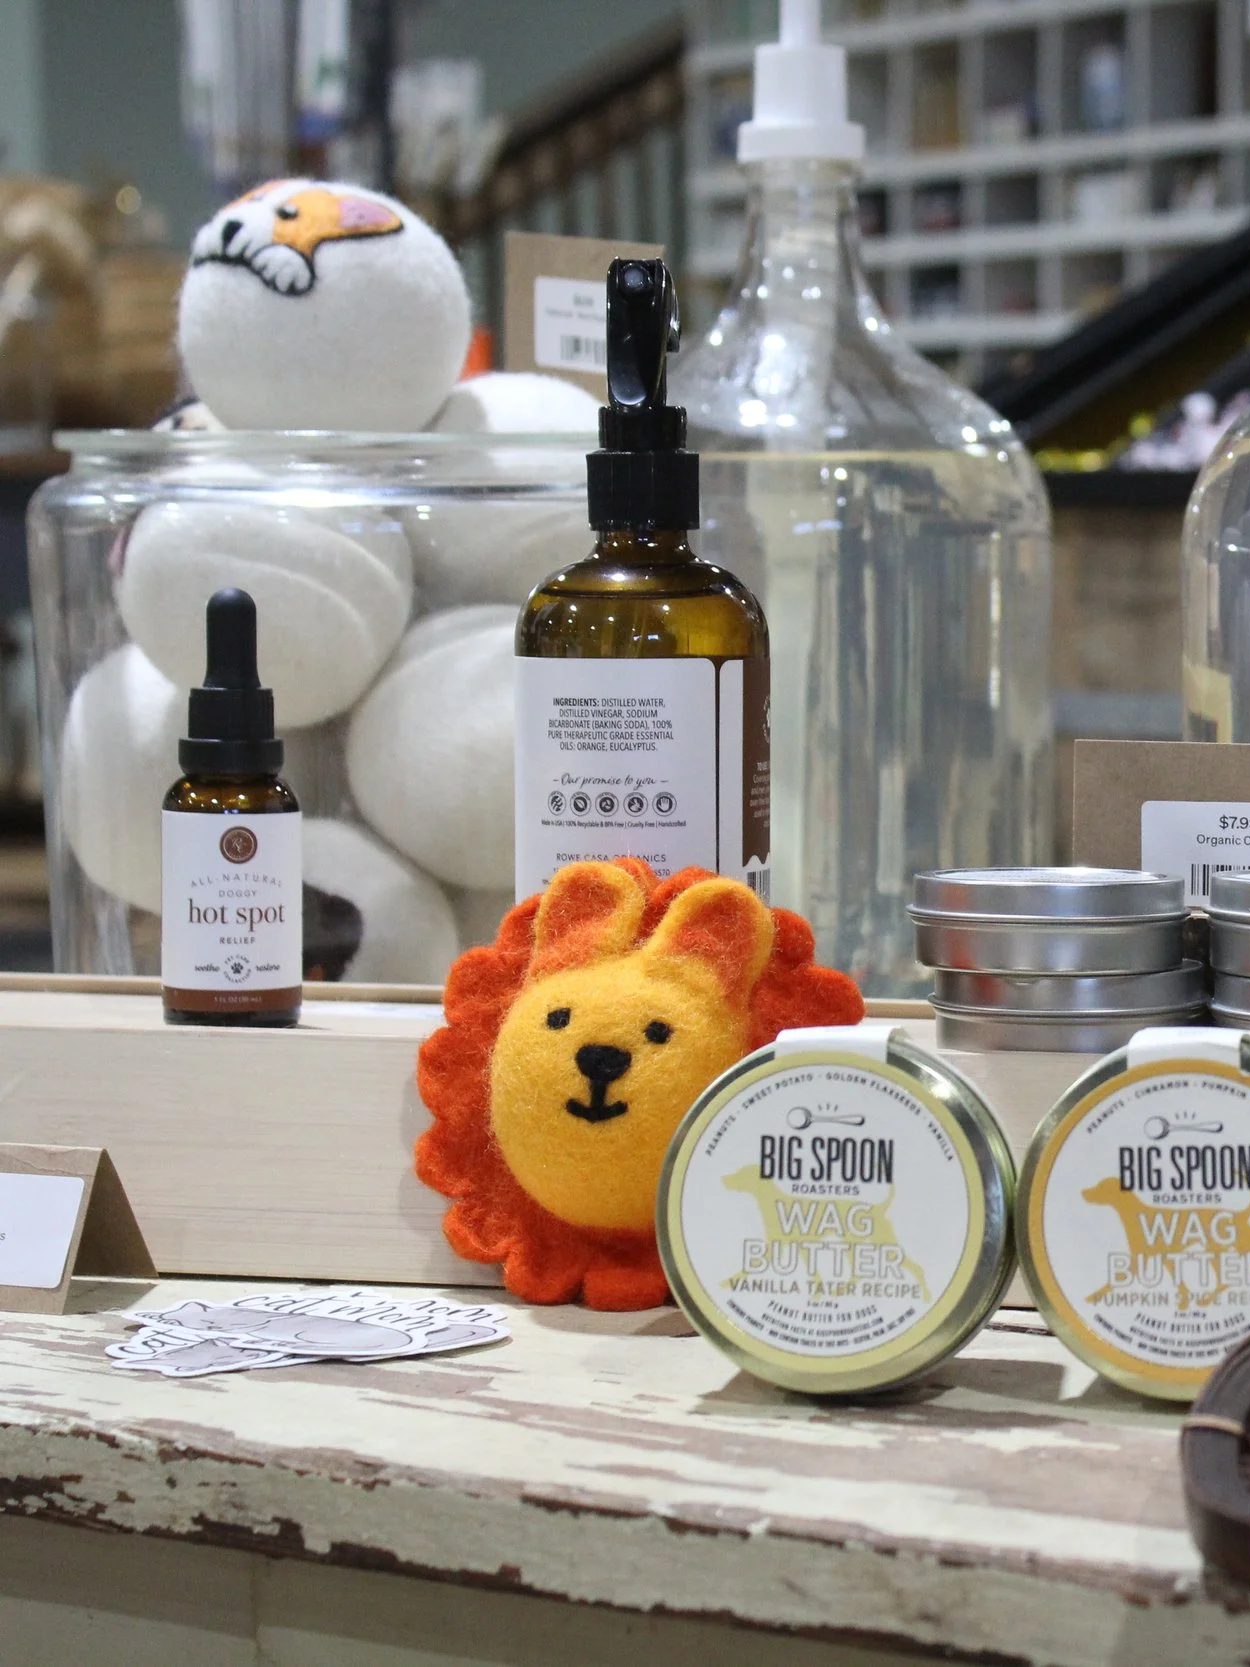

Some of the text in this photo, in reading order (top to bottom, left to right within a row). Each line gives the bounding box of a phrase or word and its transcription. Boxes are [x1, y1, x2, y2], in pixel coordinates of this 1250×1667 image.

[553, 697, 666, 708] INGREDIENTS: DISTILLED WATER,
[559, 708, 658, 719] DISTILLED VINEGAR, SODIUM
[548, 719, 673, 730] BICARBONATE (BAKING SODA), 100%
[548, 730, 674, 740] PURE THERAPEUTIC GRADE ESSENTIAL
[560, 741, 658, 752] OILS: ORANGE, EUCALYPTUS.
[561, 772, 657, 791] Our promise to you
[1196, 834, 1241, 847] Organic
[556, 853, 580, 861] ROWE
[218, 889, 258, 898] DOGGY
[188, 898, 285, 932] hot spot
[219, 936, 256, 945] RELIEF
[1086, 1099, 1125, 1134] PEANUTS
[1134, 1080, 1189, 1099] CINNAMON
[1202, 1080, 1247, 1098] PUMPKIN
[705, 1115, 736, 1157] PEANUTS
[742, 1085, 773, 1110] SWEET
[774, 1072, 813, 1090] POTATO
[826, 1071, 867, 1085] GOLDEN
[928, 1121, 953, 1162] VANILLA
[760, 1135, 894, 1184] BIG SPOON
[1119, 1146, 1162, 1191] BIG
[791, 1183, 861, 1196] ROASTERS
[1152, 1193, 1222, 1204] ROASTERS
[775, 1199, 875, 1238] WAG
[1138, 1211, 1238, 1248] WAG
[742, 1237, 906, 1280] BUTTER
[730, 1277, 921, 1299] VANILLA TATER RECIPE
[1092, 1291, 1169, 1307] PUMPKIN
[233, 1295, 435, 1332] cat mom
[118, 1328, 204, 1355] cat
